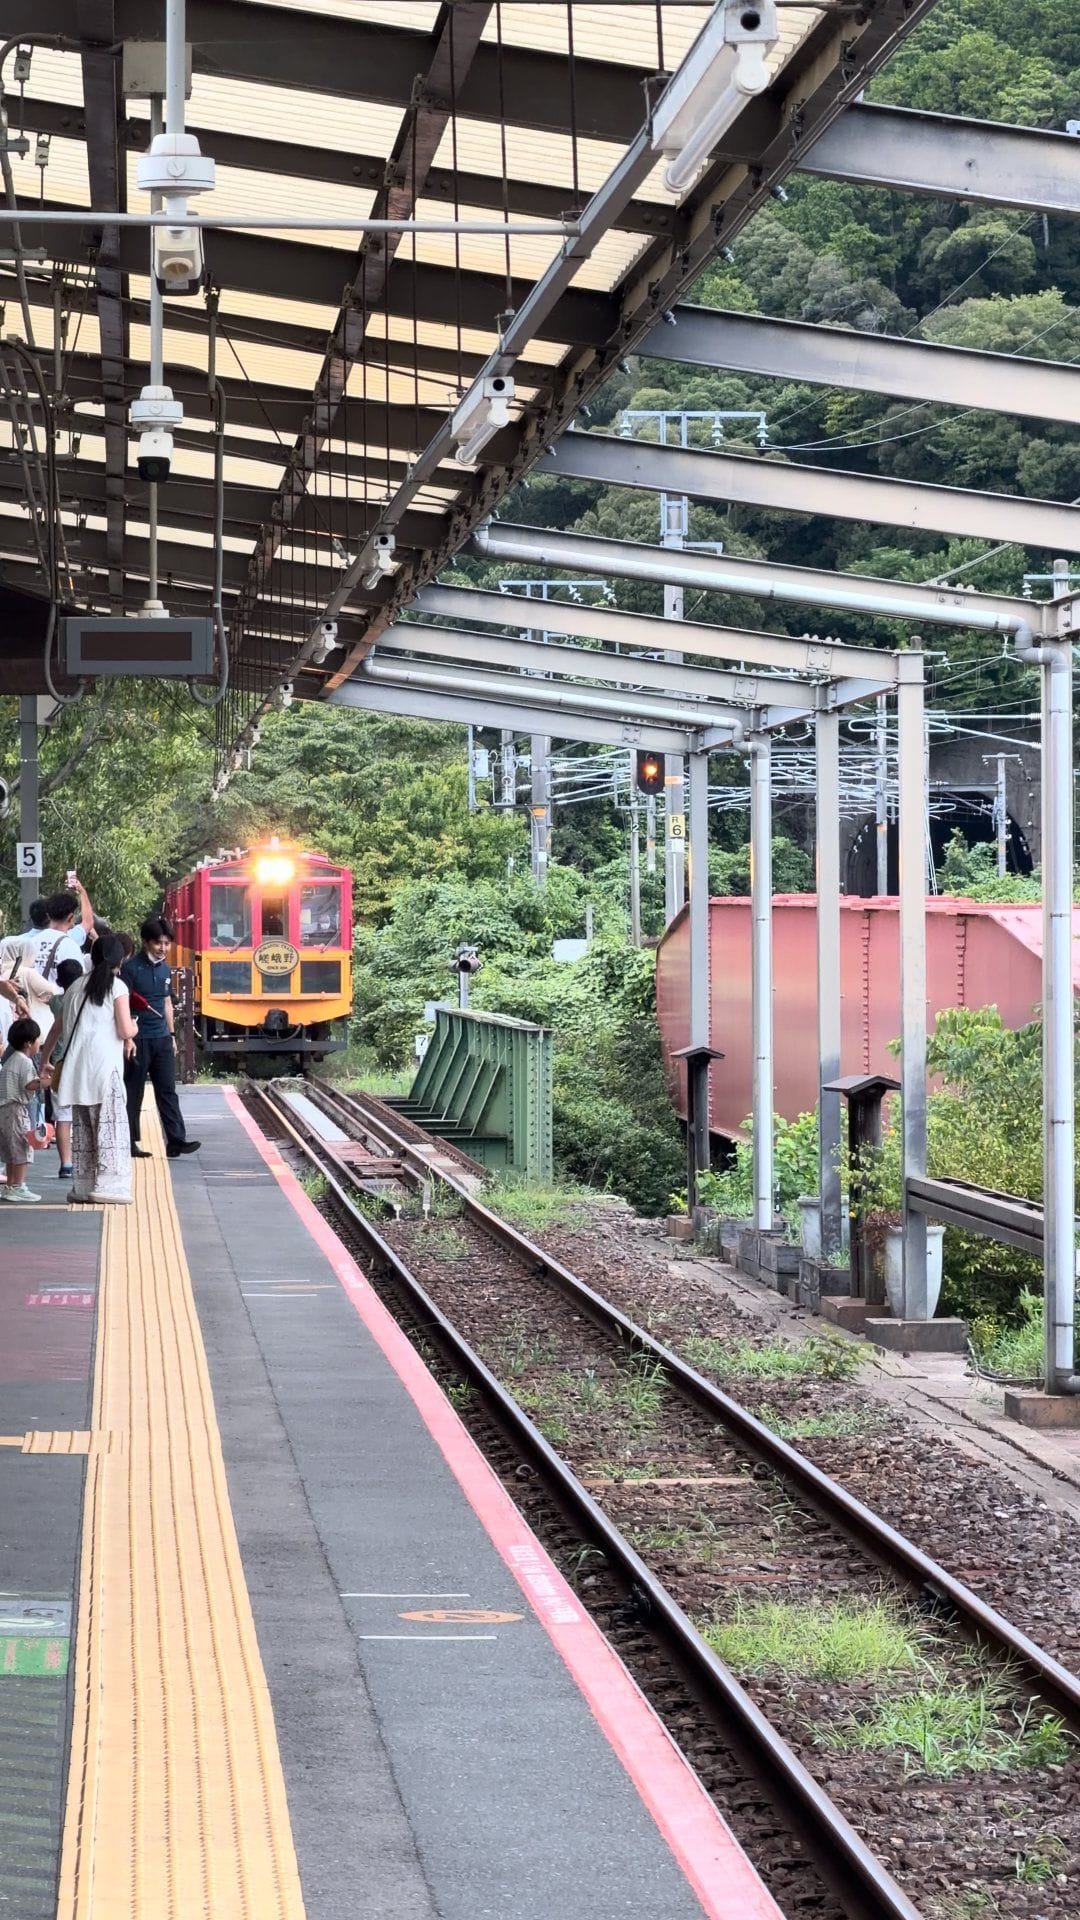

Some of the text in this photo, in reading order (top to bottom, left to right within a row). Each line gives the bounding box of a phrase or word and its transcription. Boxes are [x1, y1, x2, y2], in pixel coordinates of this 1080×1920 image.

[672, 824, 682, 836] 6
[23, 846, 36, 867] 5
[418, 1036, 427, 1047] 7
